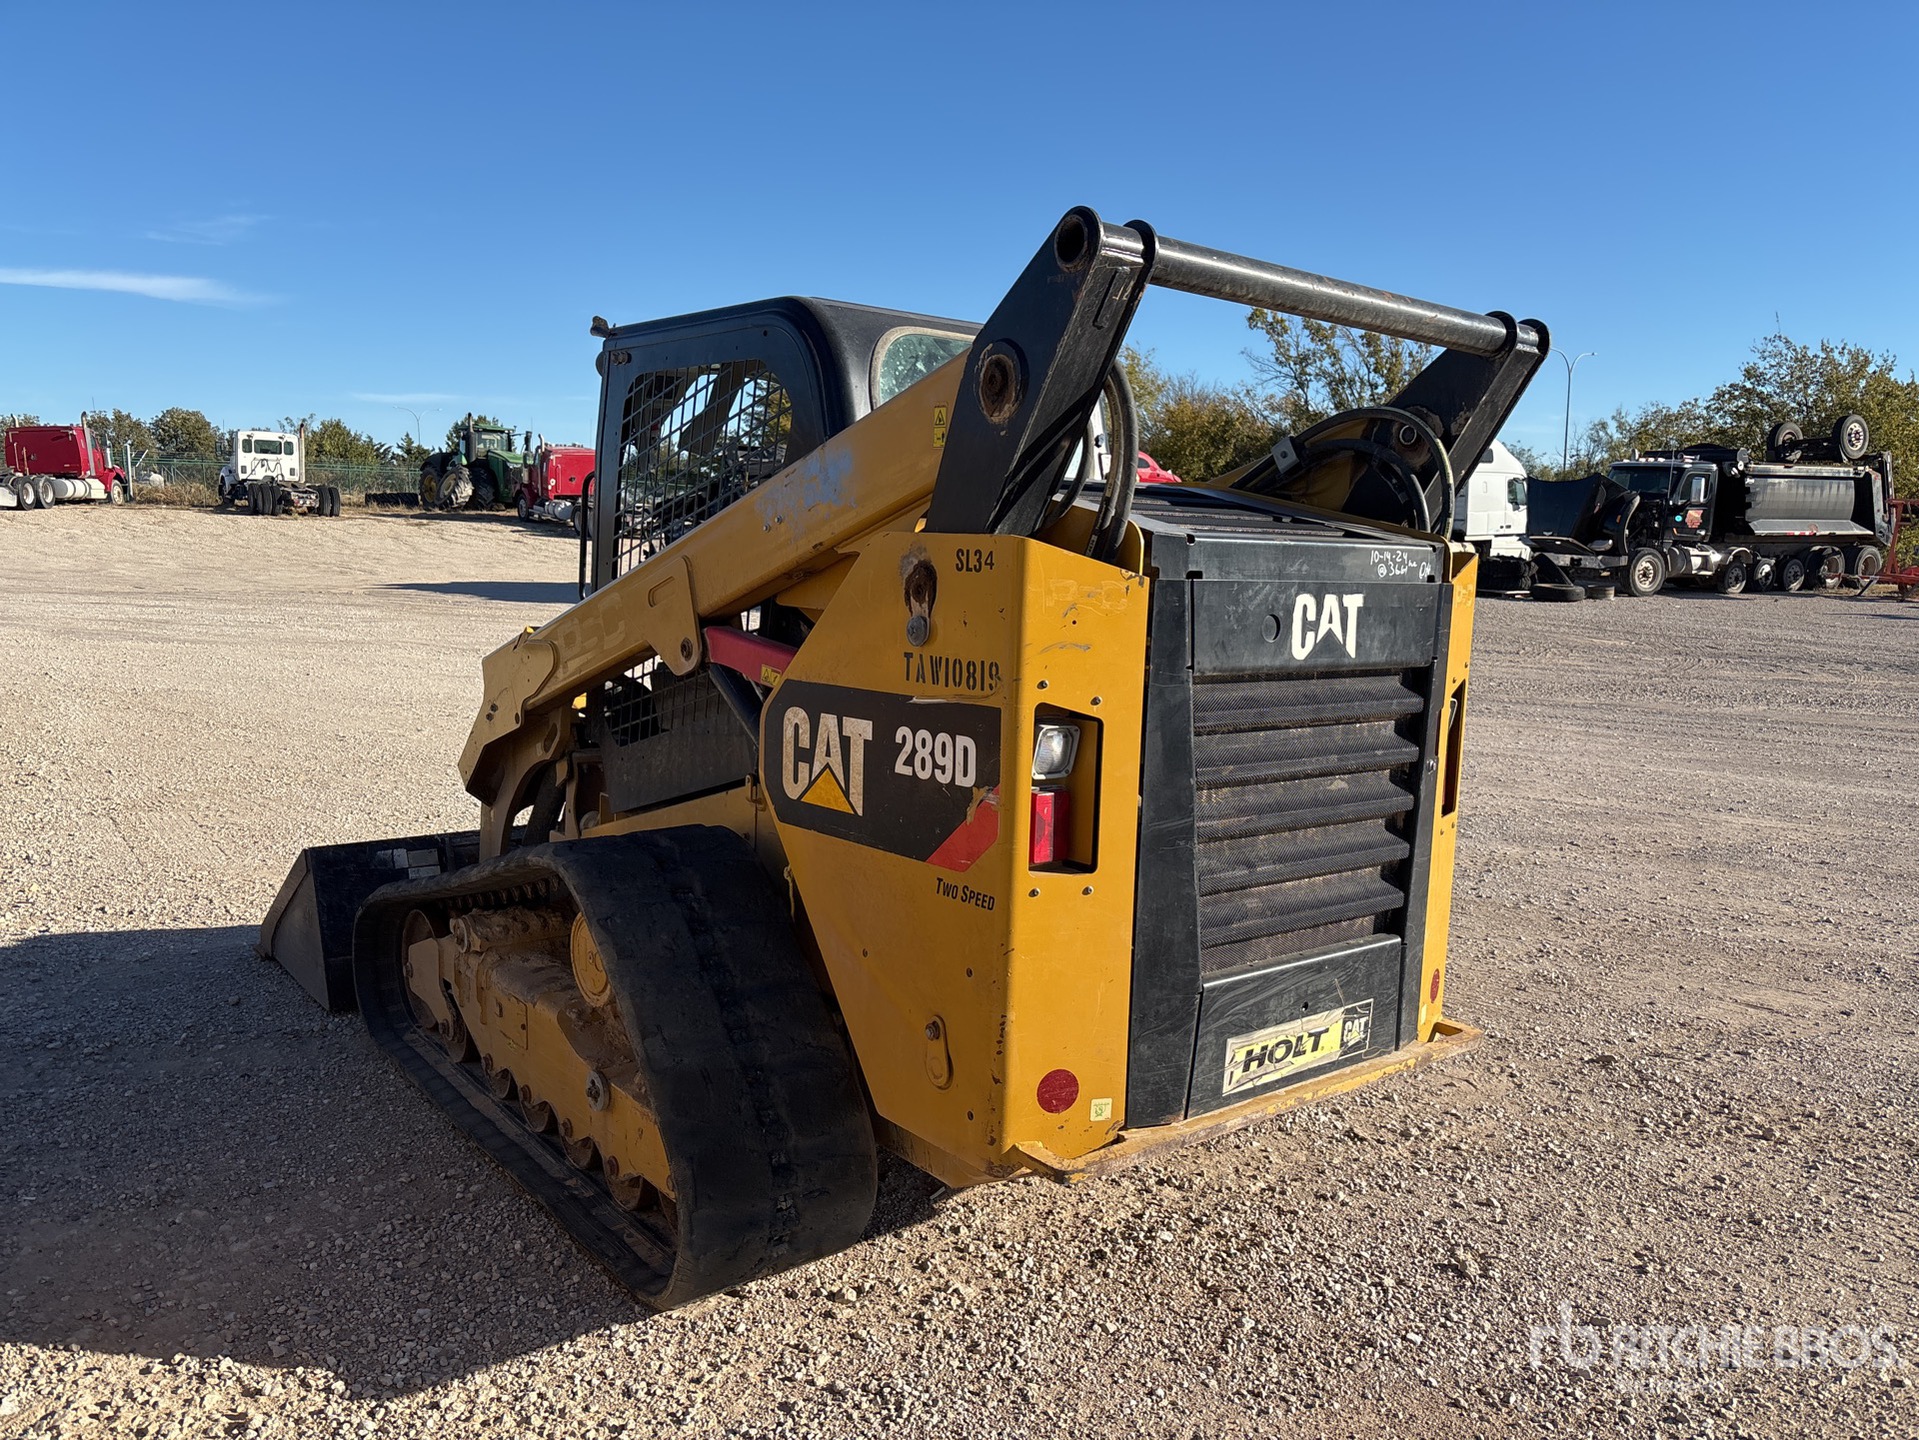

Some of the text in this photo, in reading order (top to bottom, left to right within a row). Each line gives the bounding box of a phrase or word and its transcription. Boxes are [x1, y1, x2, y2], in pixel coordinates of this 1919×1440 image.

[956, 548, 995, 573] SL34
[1292, 593, 1365, 661] CAT
[903, 651, 1000, 692] TAW10819
[782, 706, 977, 817] CAT 289D
[1241, 1016, 1369, 1073] HOLT CAT
